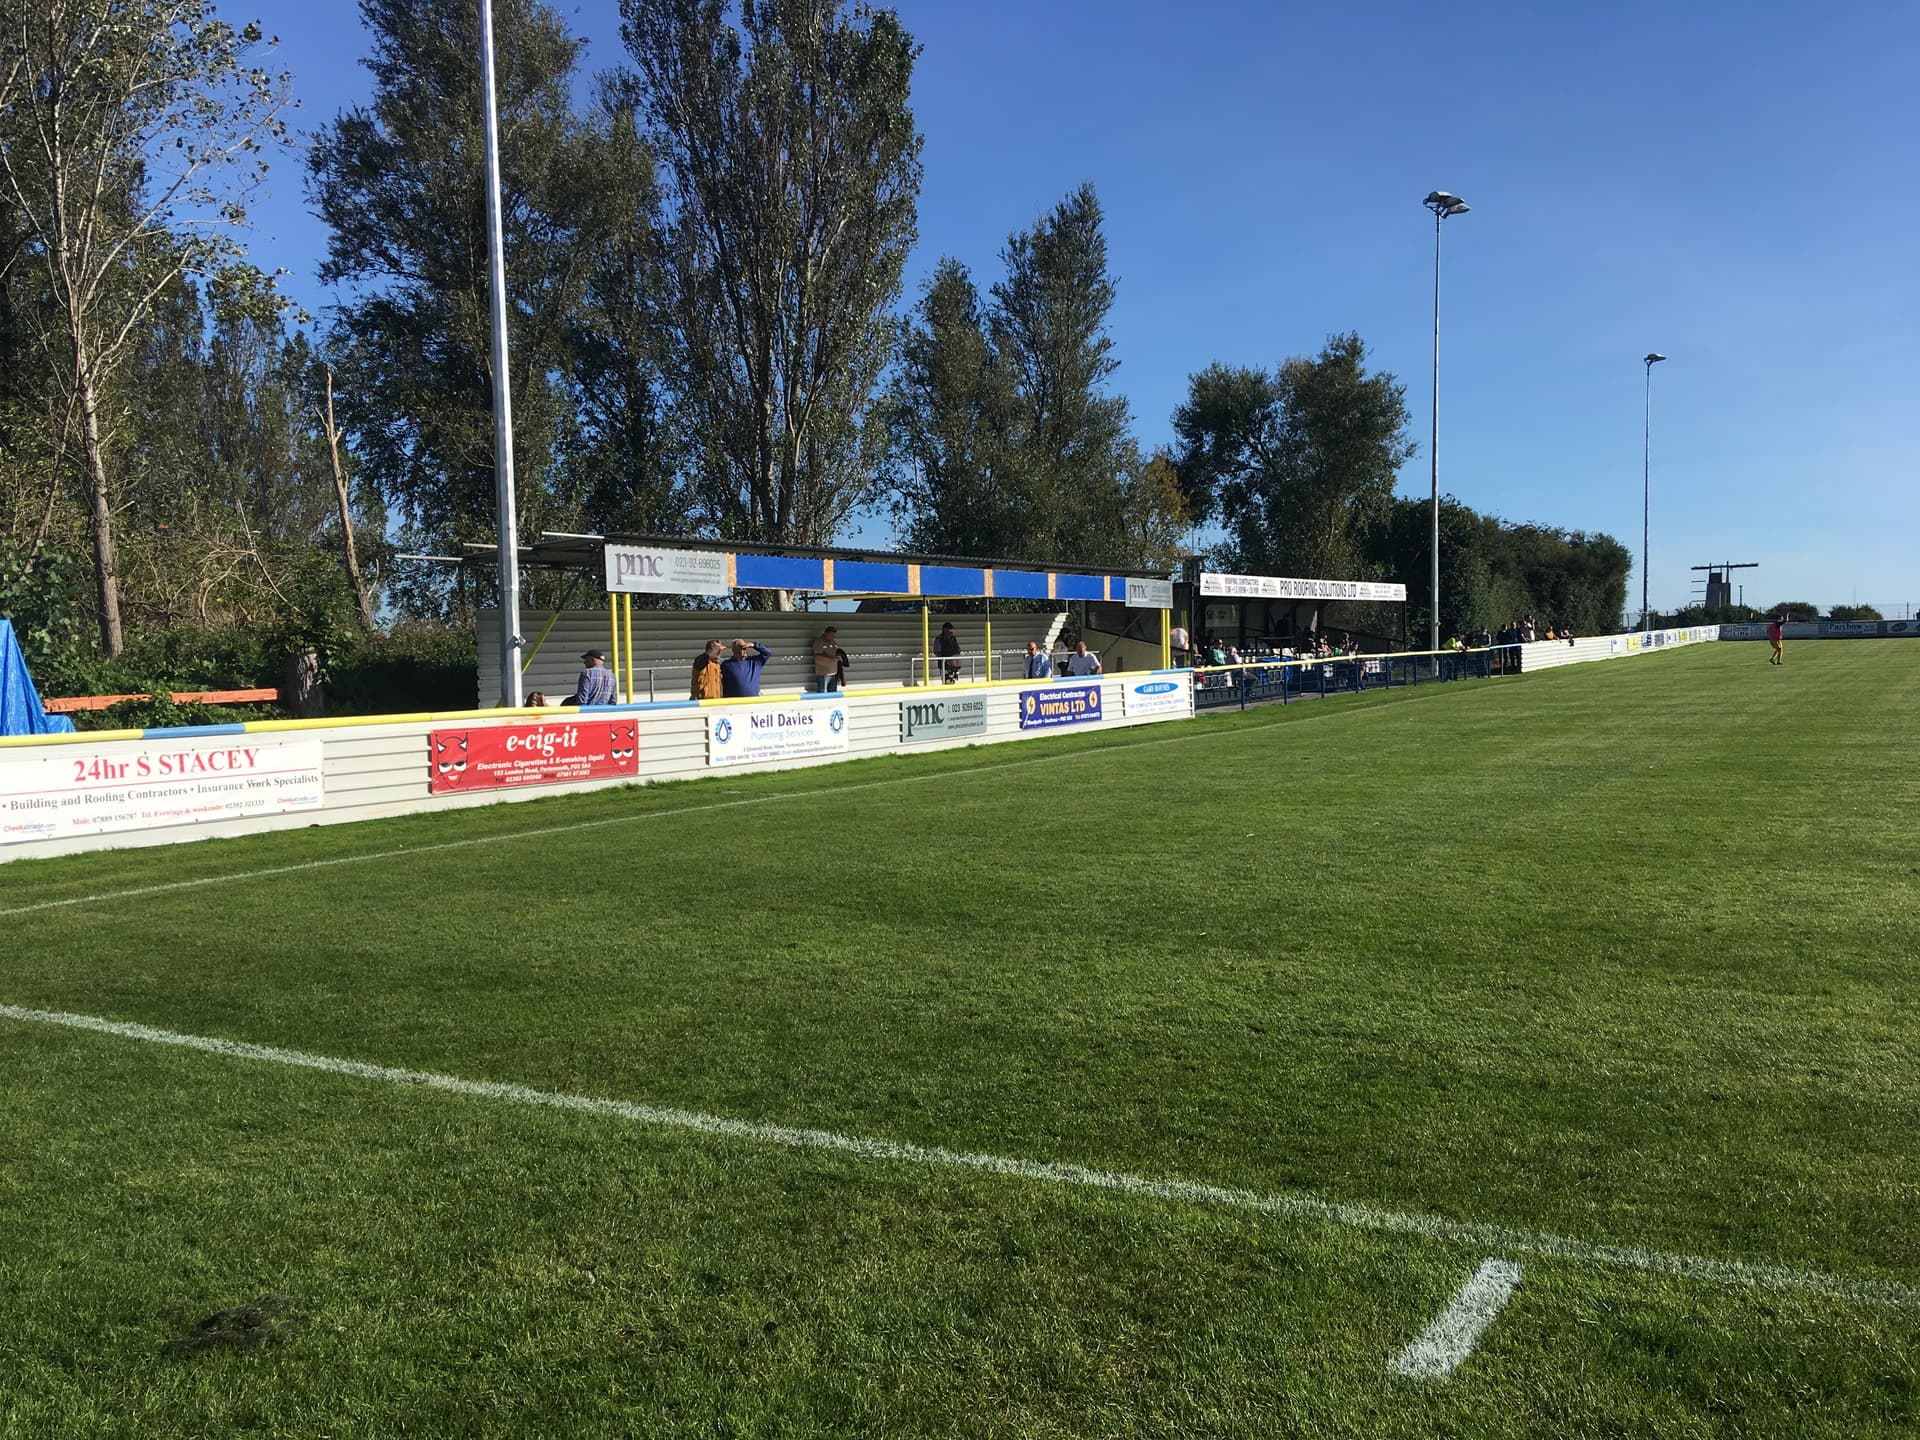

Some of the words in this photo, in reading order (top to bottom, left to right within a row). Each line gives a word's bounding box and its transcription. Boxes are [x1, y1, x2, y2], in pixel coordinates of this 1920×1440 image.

[615, 553, 663, 585] pmc
[1129, 584, 1148, 605] pmc
[1280, 581, 1292, 596] PRO
[1293, 581, 1317, 597] ROOFING
[1319, 582, 1346, 597] SOLUTIONS
[1347, 584, 1357, 597] LTD
[1040, 692, 1061, 700] Electrical
[1040, 701, 1069, 716] VINTAS
[1071, 700, 1085, 712] LTD
[750, 714, 773, 729] Neil
[778, 713, 814, 727] Davies
[906, 702, 944, 737] pmc
[506, 725, 578, 757] e-cig-it
[751, 730, 784, 741] Plumbing
[786, 728, 814, 738] Services
[73, 756, 130, 782] 24hr
[136, 755, 151, 777] S
[159, 748, 260, 775] STACEY
[477, 761, 512, 770] Electronic
[514, 759, 547, 768] Cigarettes
[10, 797, 58, 811] Building
[61, 795, 81, 807] and
[84, 791, 125, 804] Roofing
[127, 786, 189, 801] Contractors
[197, 782, 244, 794] Insurance
[247, 778, 272, 789] Work
[273, 774, 318, 786] Specialists
